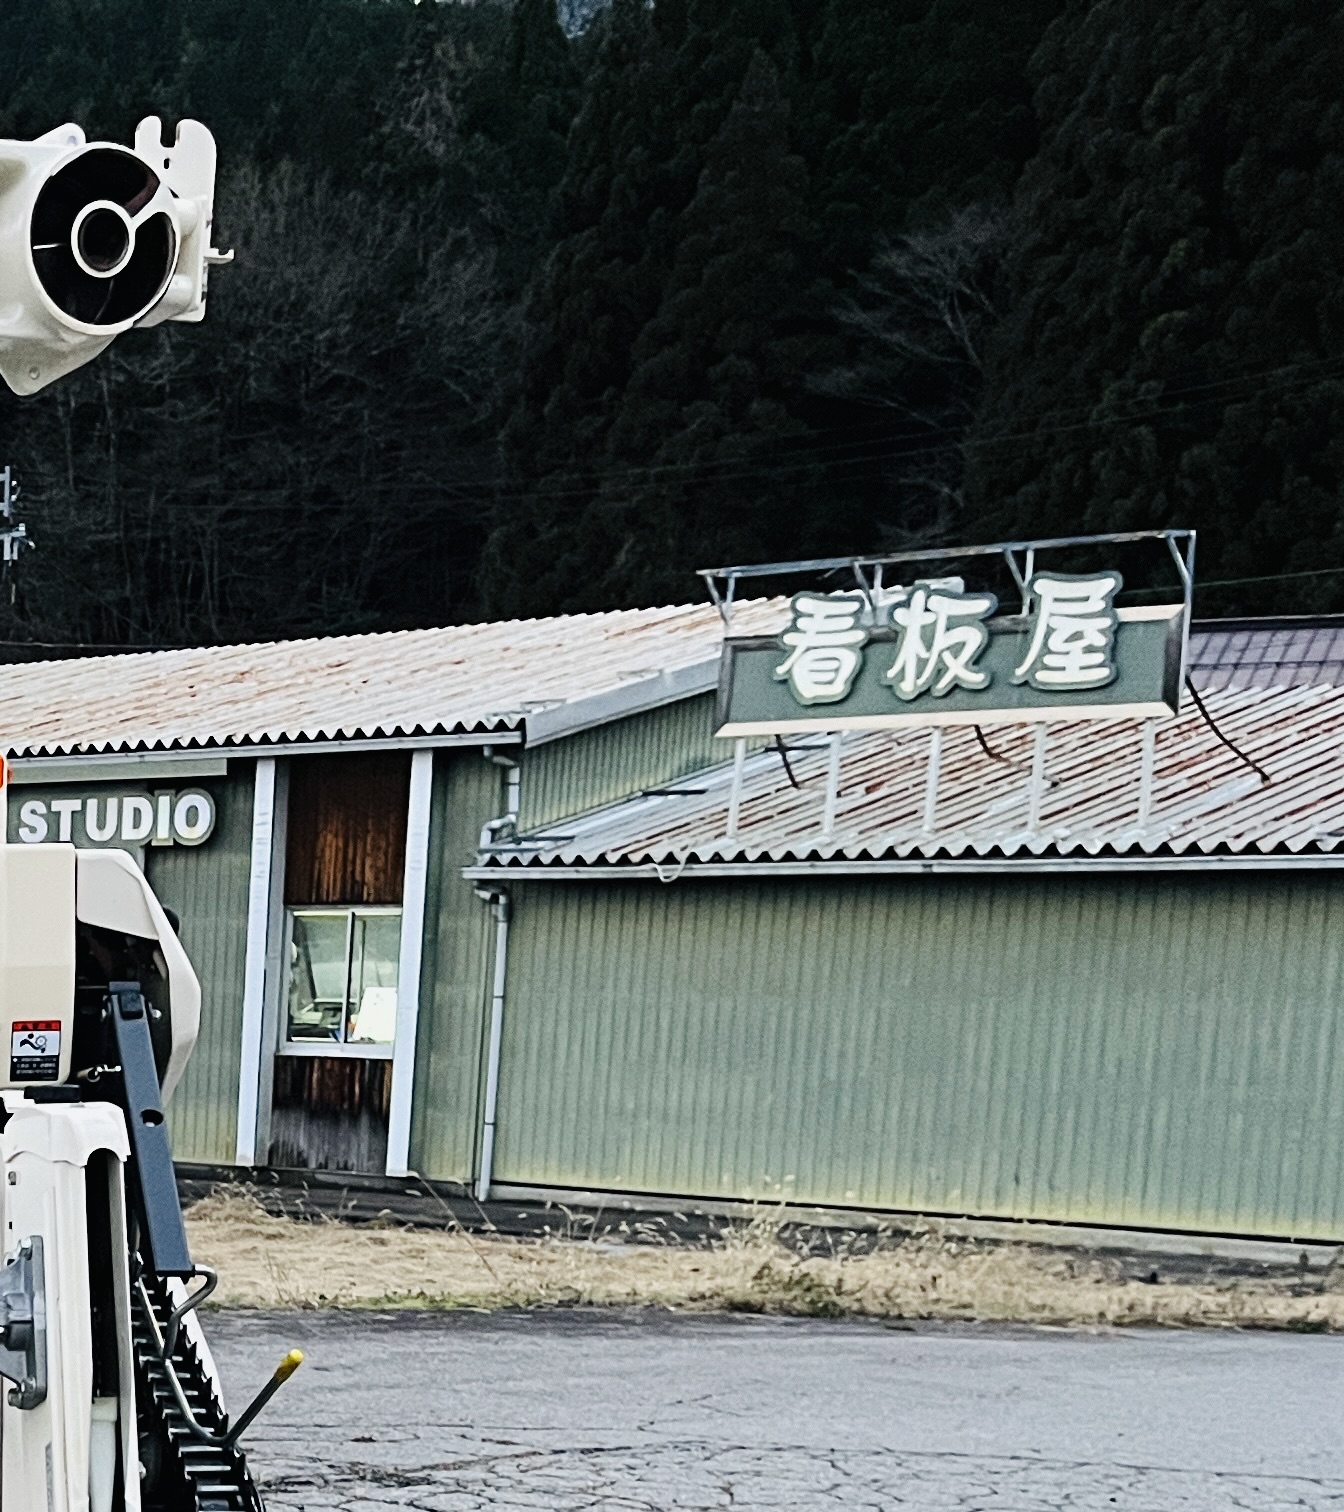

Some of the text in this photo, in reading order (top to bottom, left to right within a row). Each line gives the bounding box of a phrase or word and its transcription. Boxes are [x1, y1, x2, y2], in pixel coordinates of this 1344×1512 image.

[776, 577, 1116, 700] 看板屋
[18, 794, 212, 843] STUDIO
